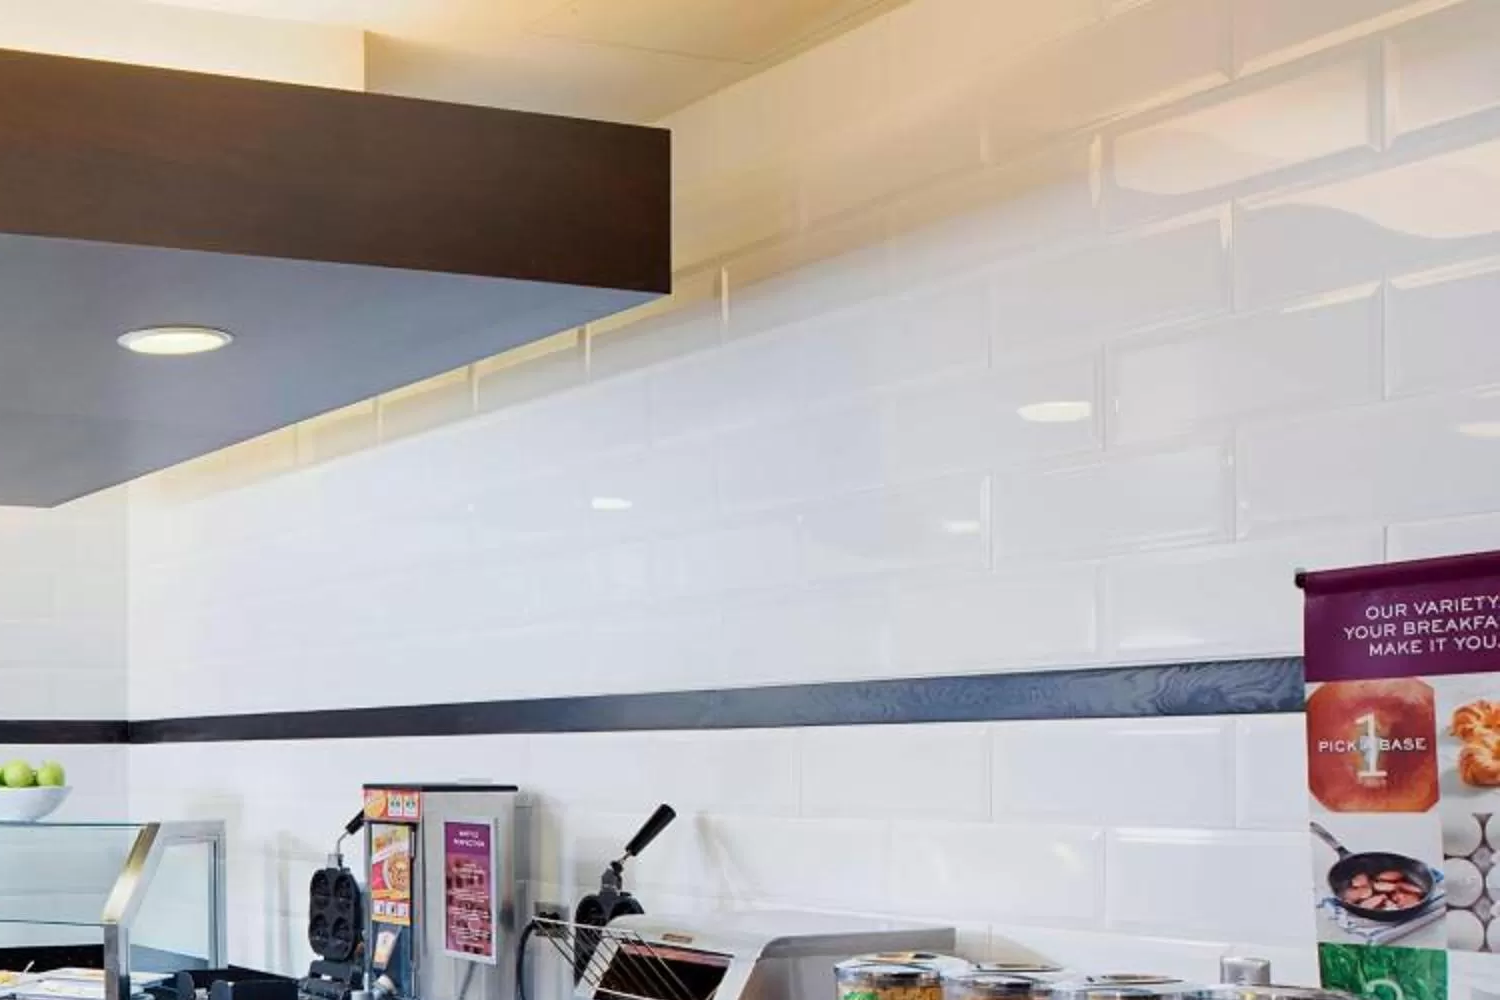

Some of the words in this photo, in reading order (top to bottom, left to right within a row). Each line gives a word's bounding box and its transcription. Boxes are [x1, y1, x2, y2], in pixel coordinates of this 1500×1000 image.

[1365, 603, 1407, 620] OUR
[1343, 623, 1397, 640] YOUR
[1368, 640, 1423, 656] MAKE
[1429, 637, 1447, 653] IT
[1318, 739, 1357, 752] PICK
[1380, 737, 1428, 751] BASE
